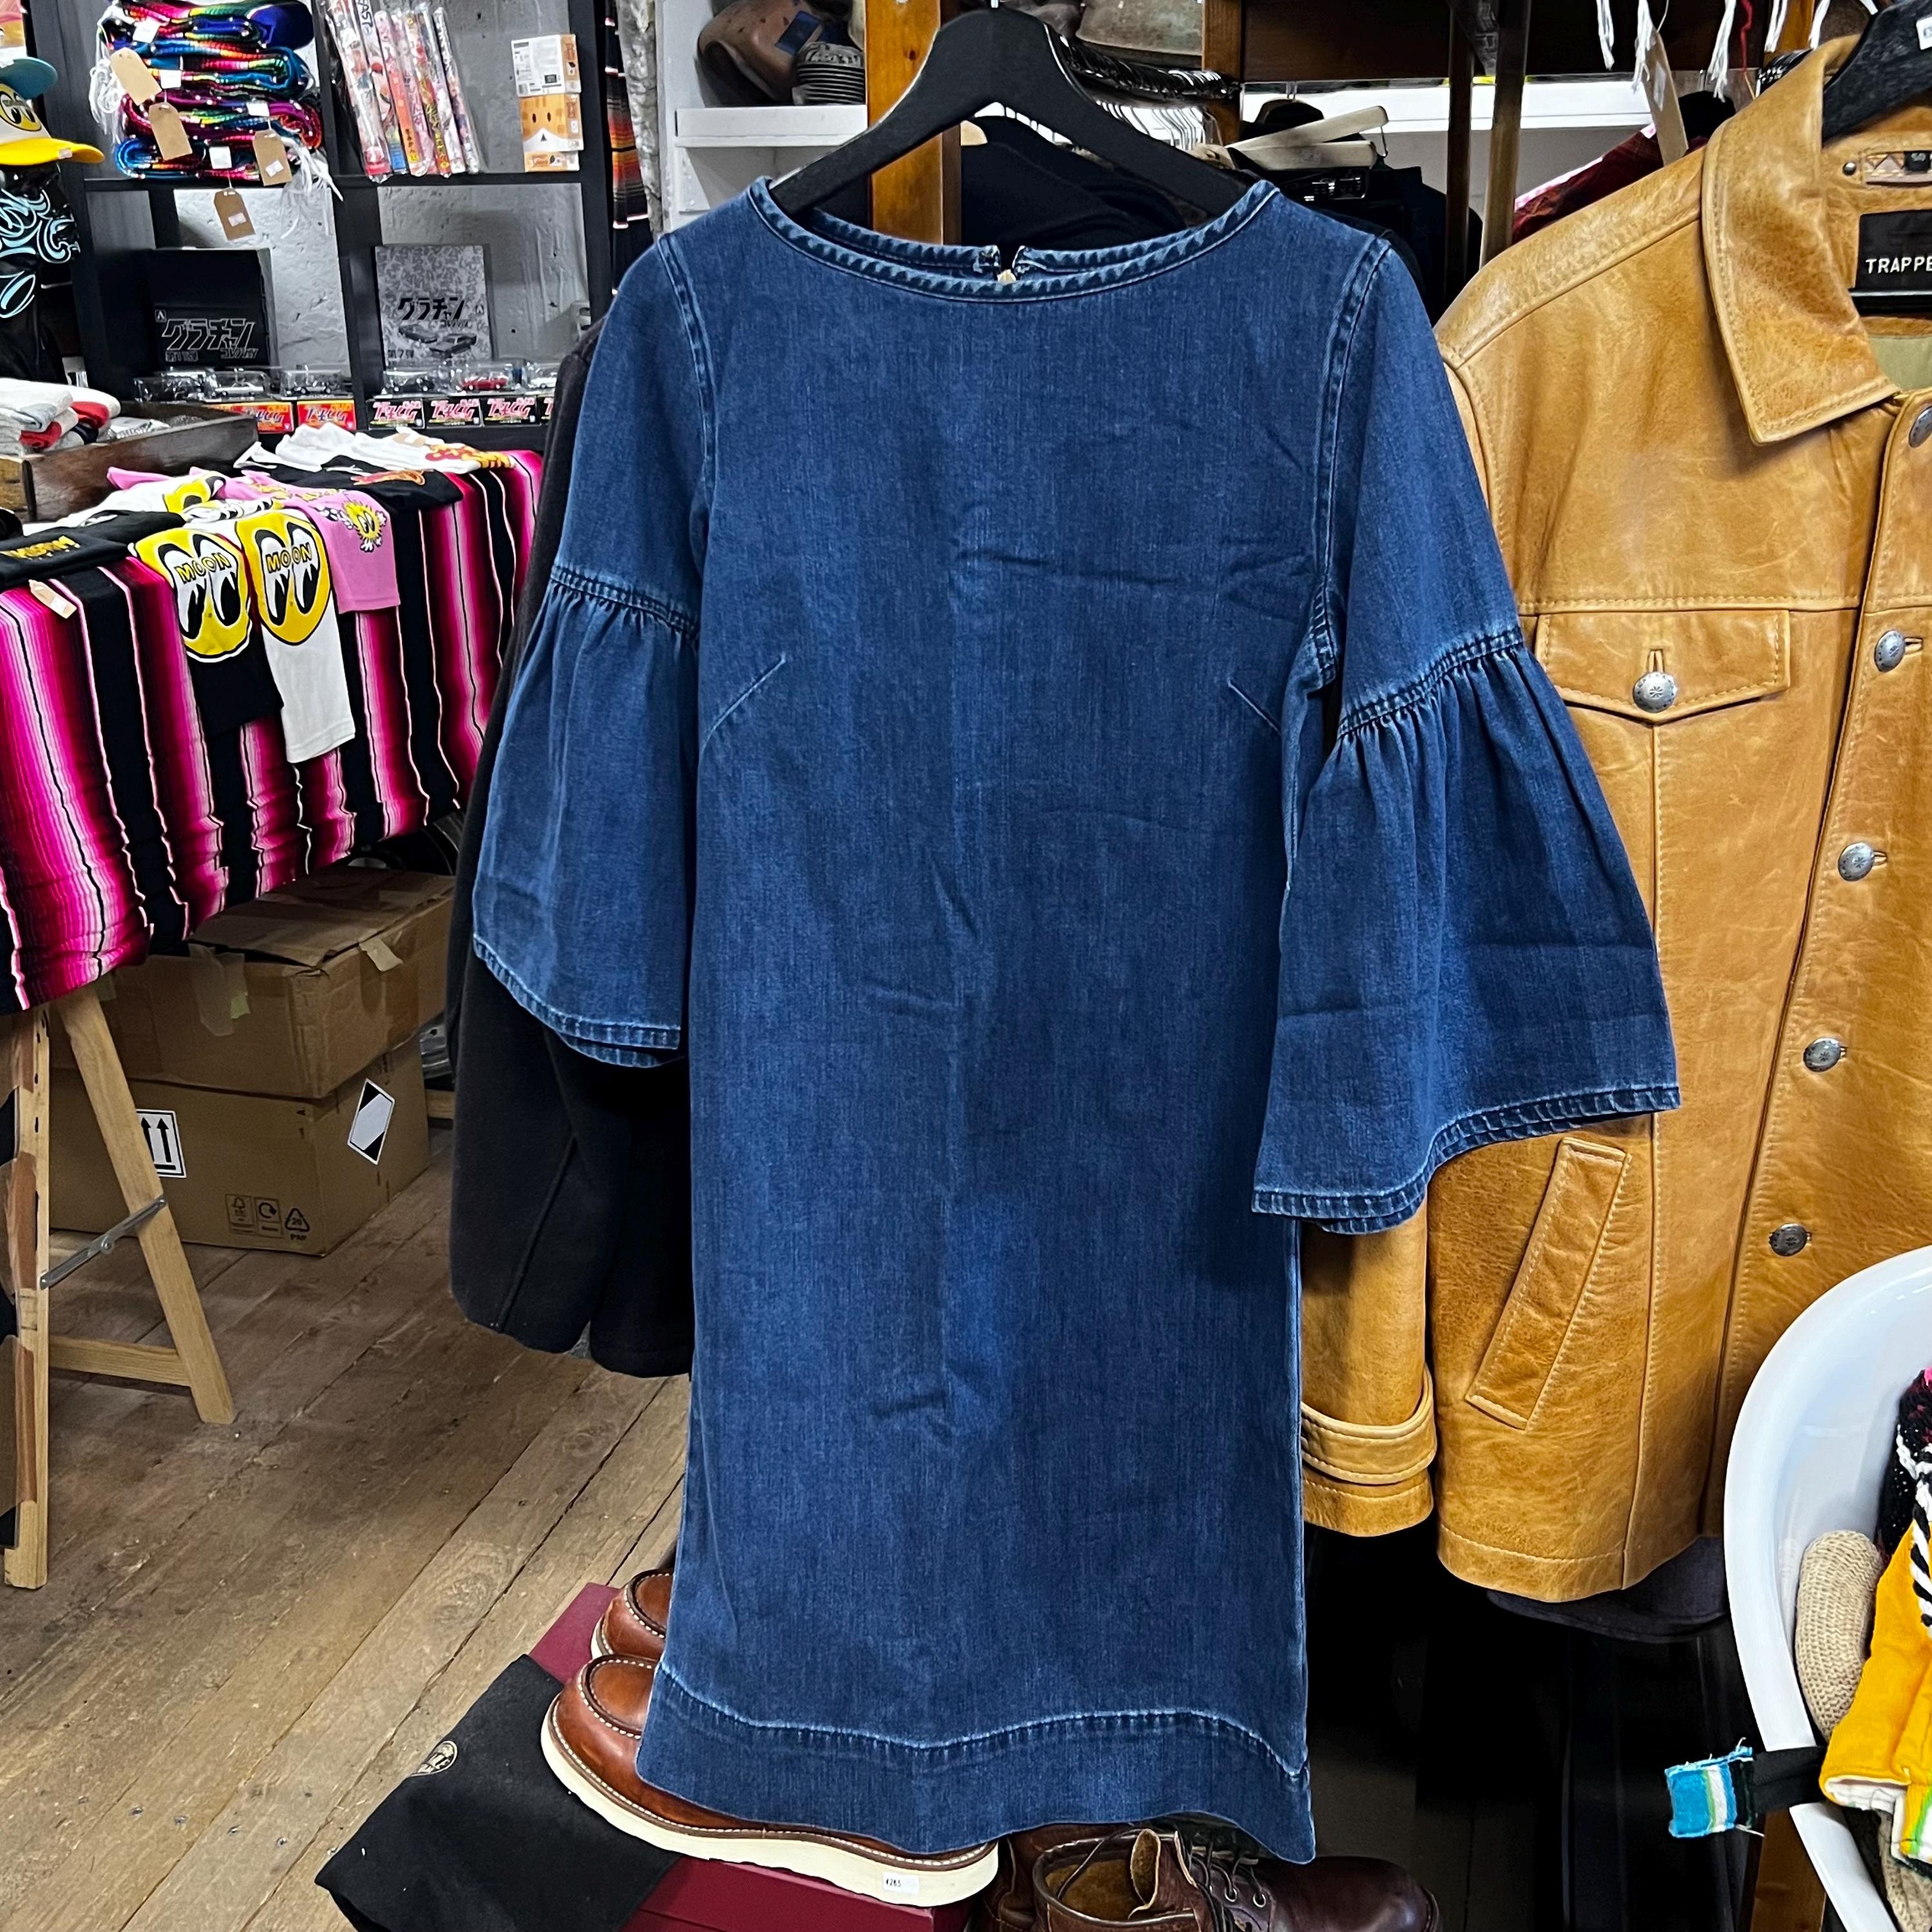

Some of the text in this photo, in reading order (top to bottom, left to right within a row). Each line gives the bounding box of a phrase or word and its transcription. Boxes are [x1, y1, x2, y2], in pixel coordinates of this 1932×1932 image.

[1865, 256, 1932, 274] TRAPPE
[175, 553, 231, 583] MOON
[265, 543, 312, 573] MOON
